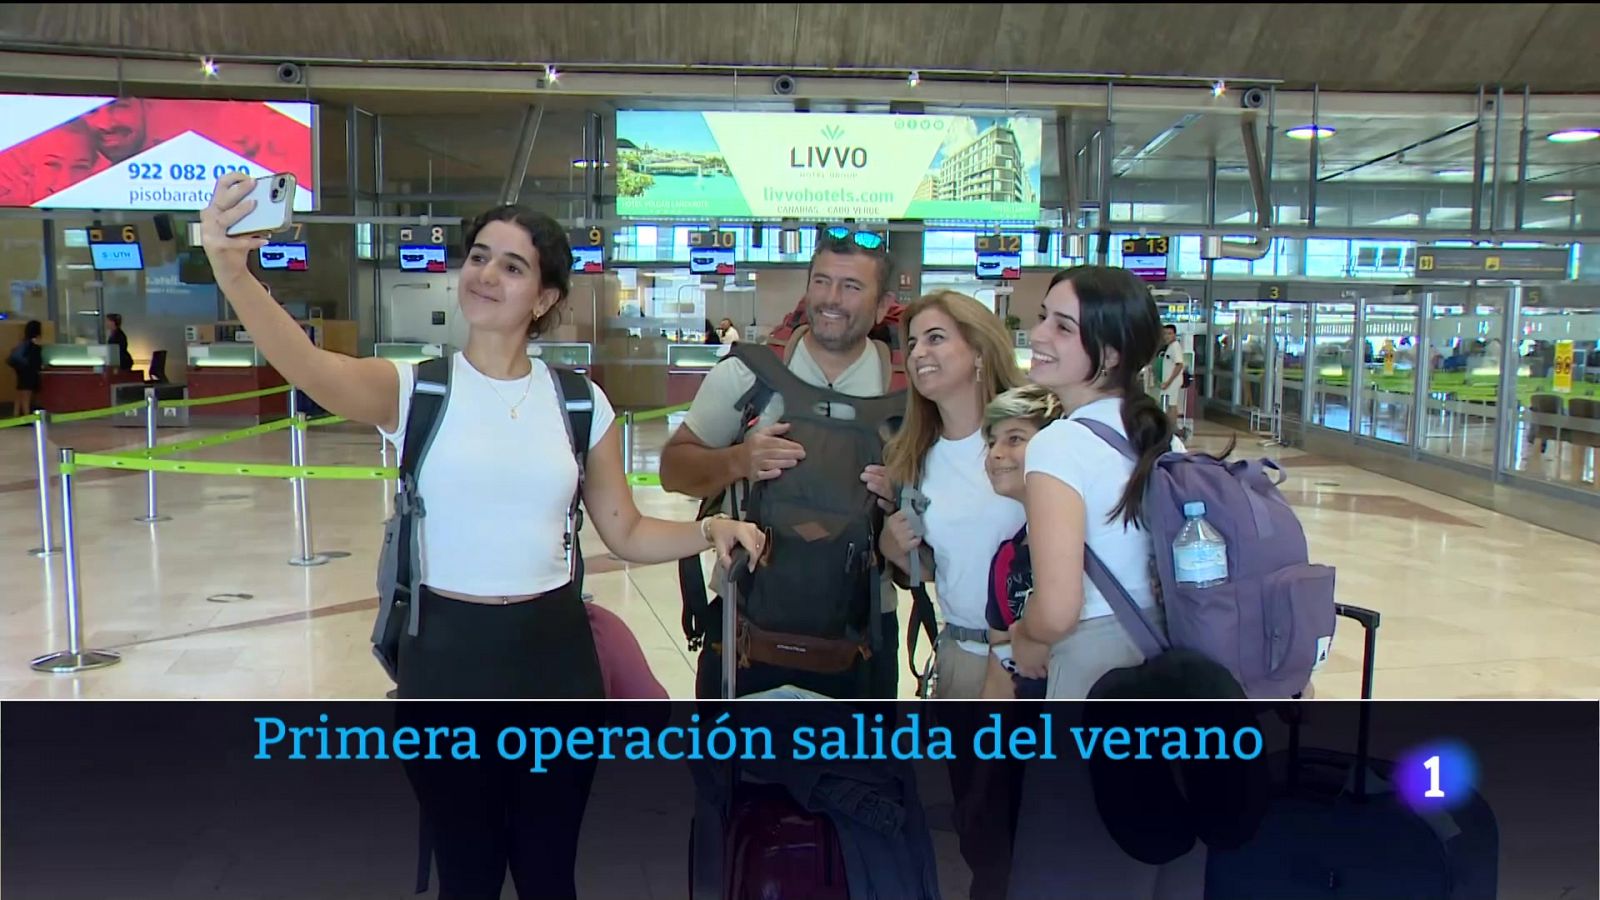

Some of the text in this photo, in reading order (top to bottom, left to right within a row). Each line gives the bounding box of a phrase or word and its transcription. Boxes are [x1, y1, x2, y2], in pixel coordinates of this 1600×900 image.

[790, 146, 868, 168] LIVVO
[128, 163, 163, 179] 922
[170, 164, 206, 180] 082
[763, 186, 895, 203] livvohotels.com
[122, 226, 135, 243] 6
[290, 223, 303, 240] 7
[431, 227, 443, 243] 8
[589, 229, 601, 246] 9
[711, 231, 734, 248] 10
[998, 236, 1020, 252] 12
[1146, 238, 1167, 253] 13
[102, 250, 131, 259] SUTH
[1269, 286, 1280, 299] 3
